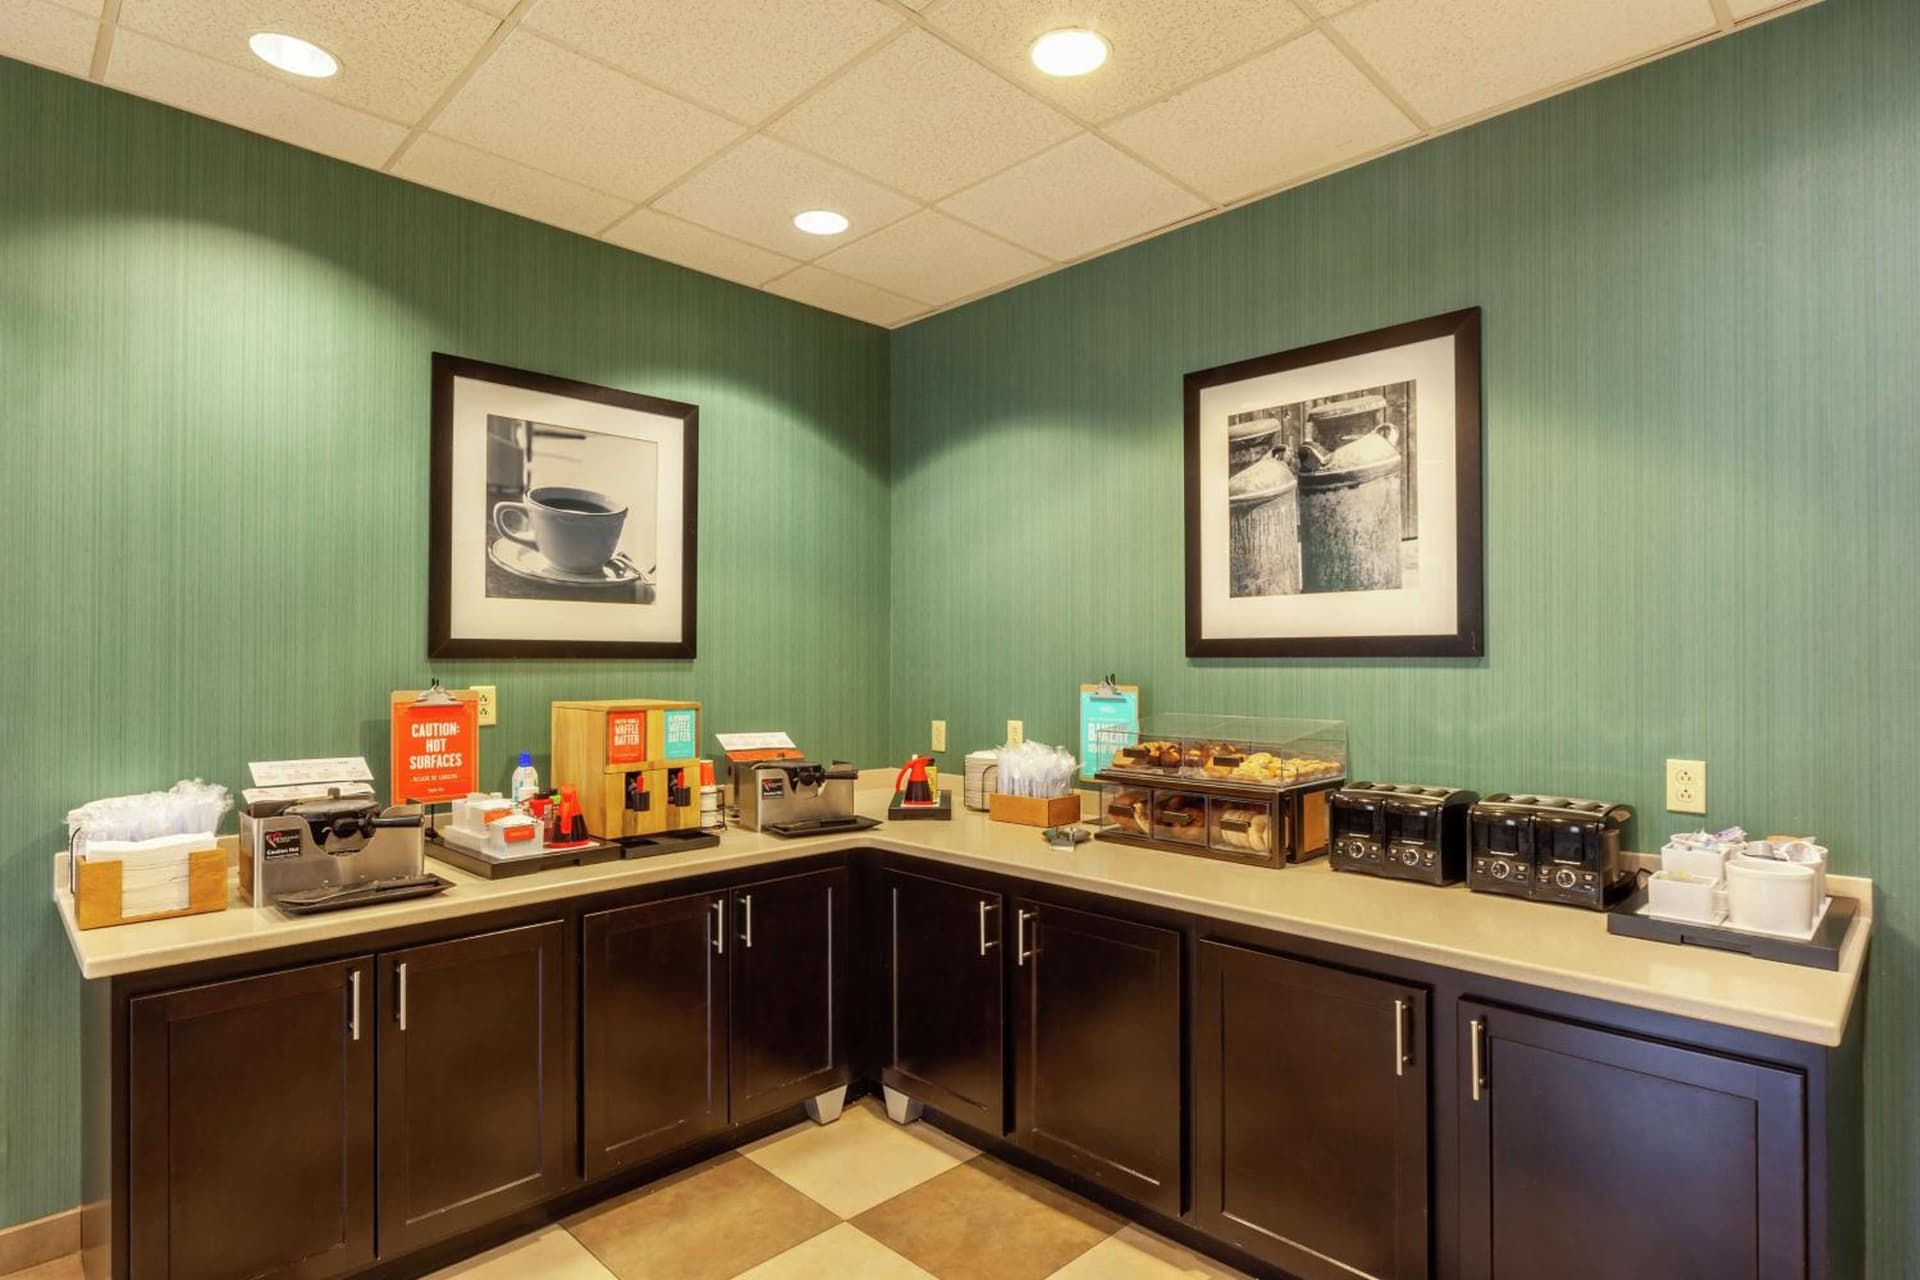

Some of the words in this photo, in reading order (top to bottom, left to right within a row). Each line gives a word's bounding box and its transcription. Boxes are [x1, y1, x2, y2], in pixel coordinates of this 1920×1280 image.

[411, 722, 460, 737] CAUTION:
[615, 724, 640, 734] WAFFLE
[425, 738, 447, 752] HOT
[614, 735, 639, 745] BATTER
[410, 753, 462, 769] SURFACES
